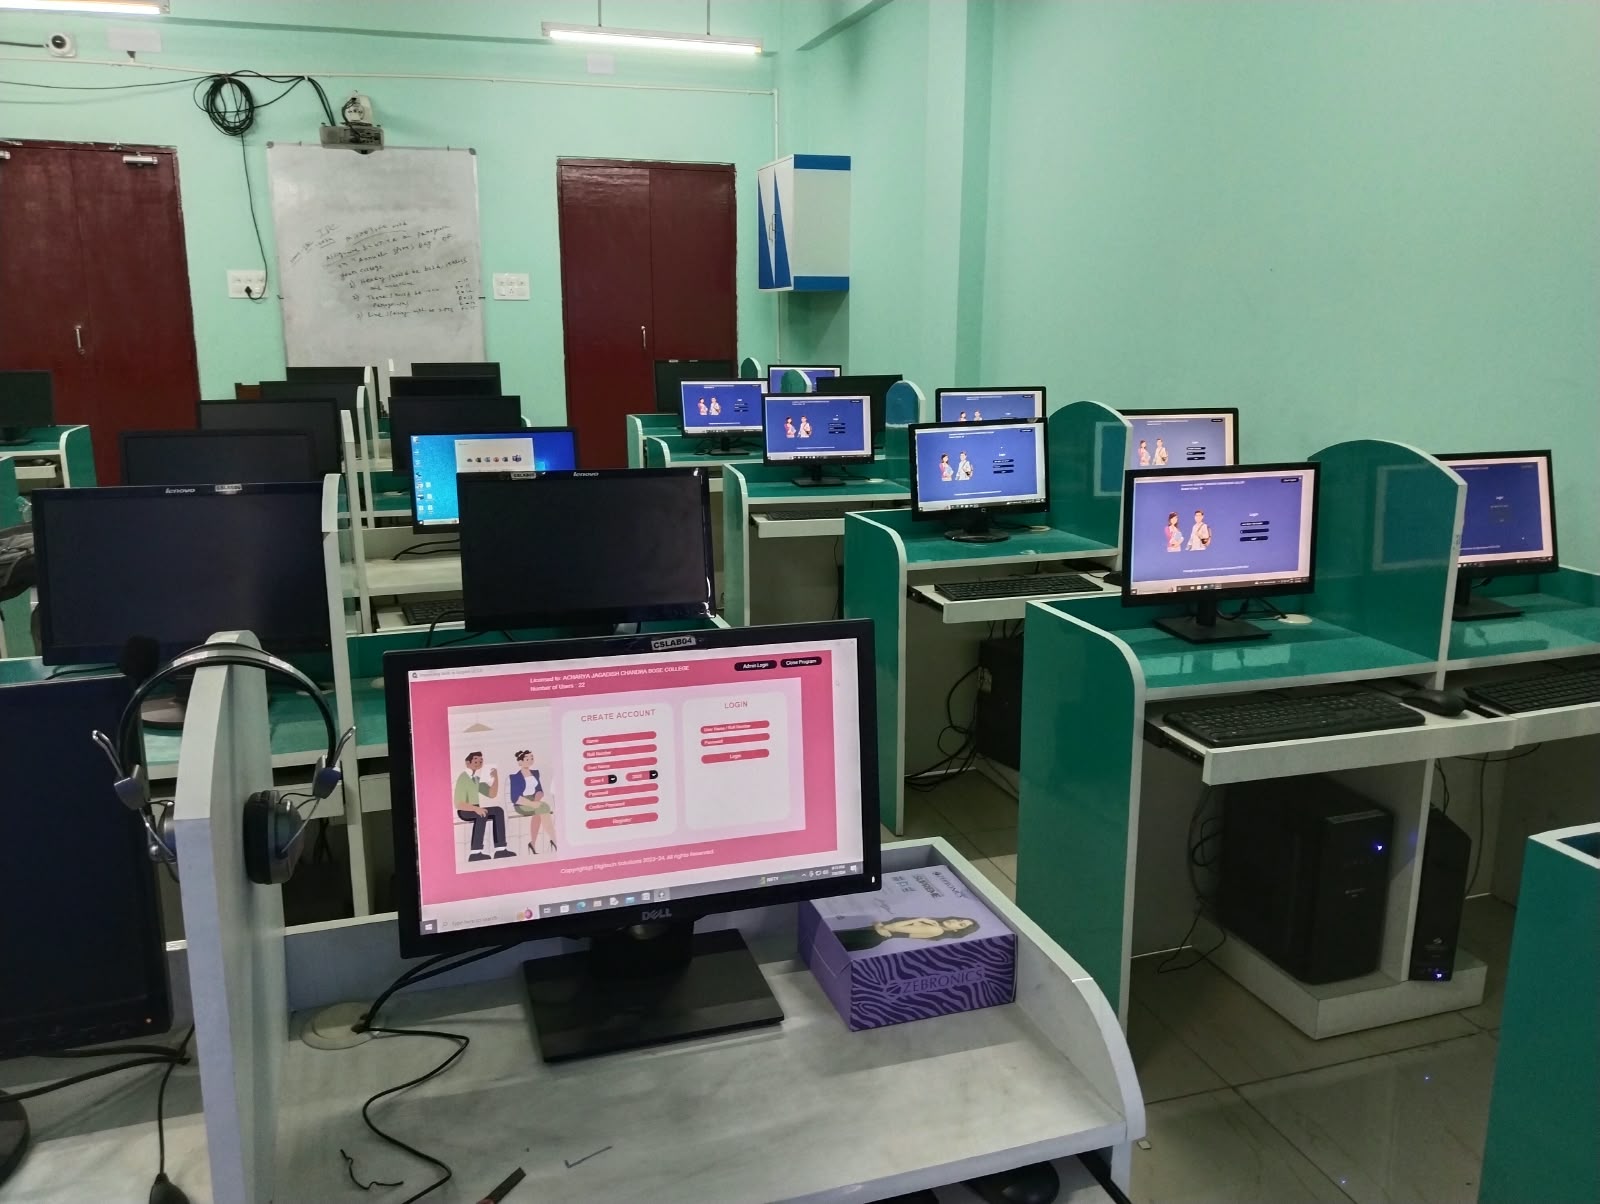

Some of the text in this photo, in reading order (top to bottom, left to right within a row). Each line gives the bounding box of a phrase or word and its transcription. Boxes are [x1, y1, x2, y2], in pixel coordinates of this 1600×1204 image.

[653, 638, 692, 649] CSLAB04
[591, 671, 620, 679] JAGADISH
[724, 701, 748, 709] LOGIN
[581, 709, 656, 722] CREATE ACCOUNT
[641, 908, 672, 921] DELL
[902, 969, 984, 993] ZEBRONICS
